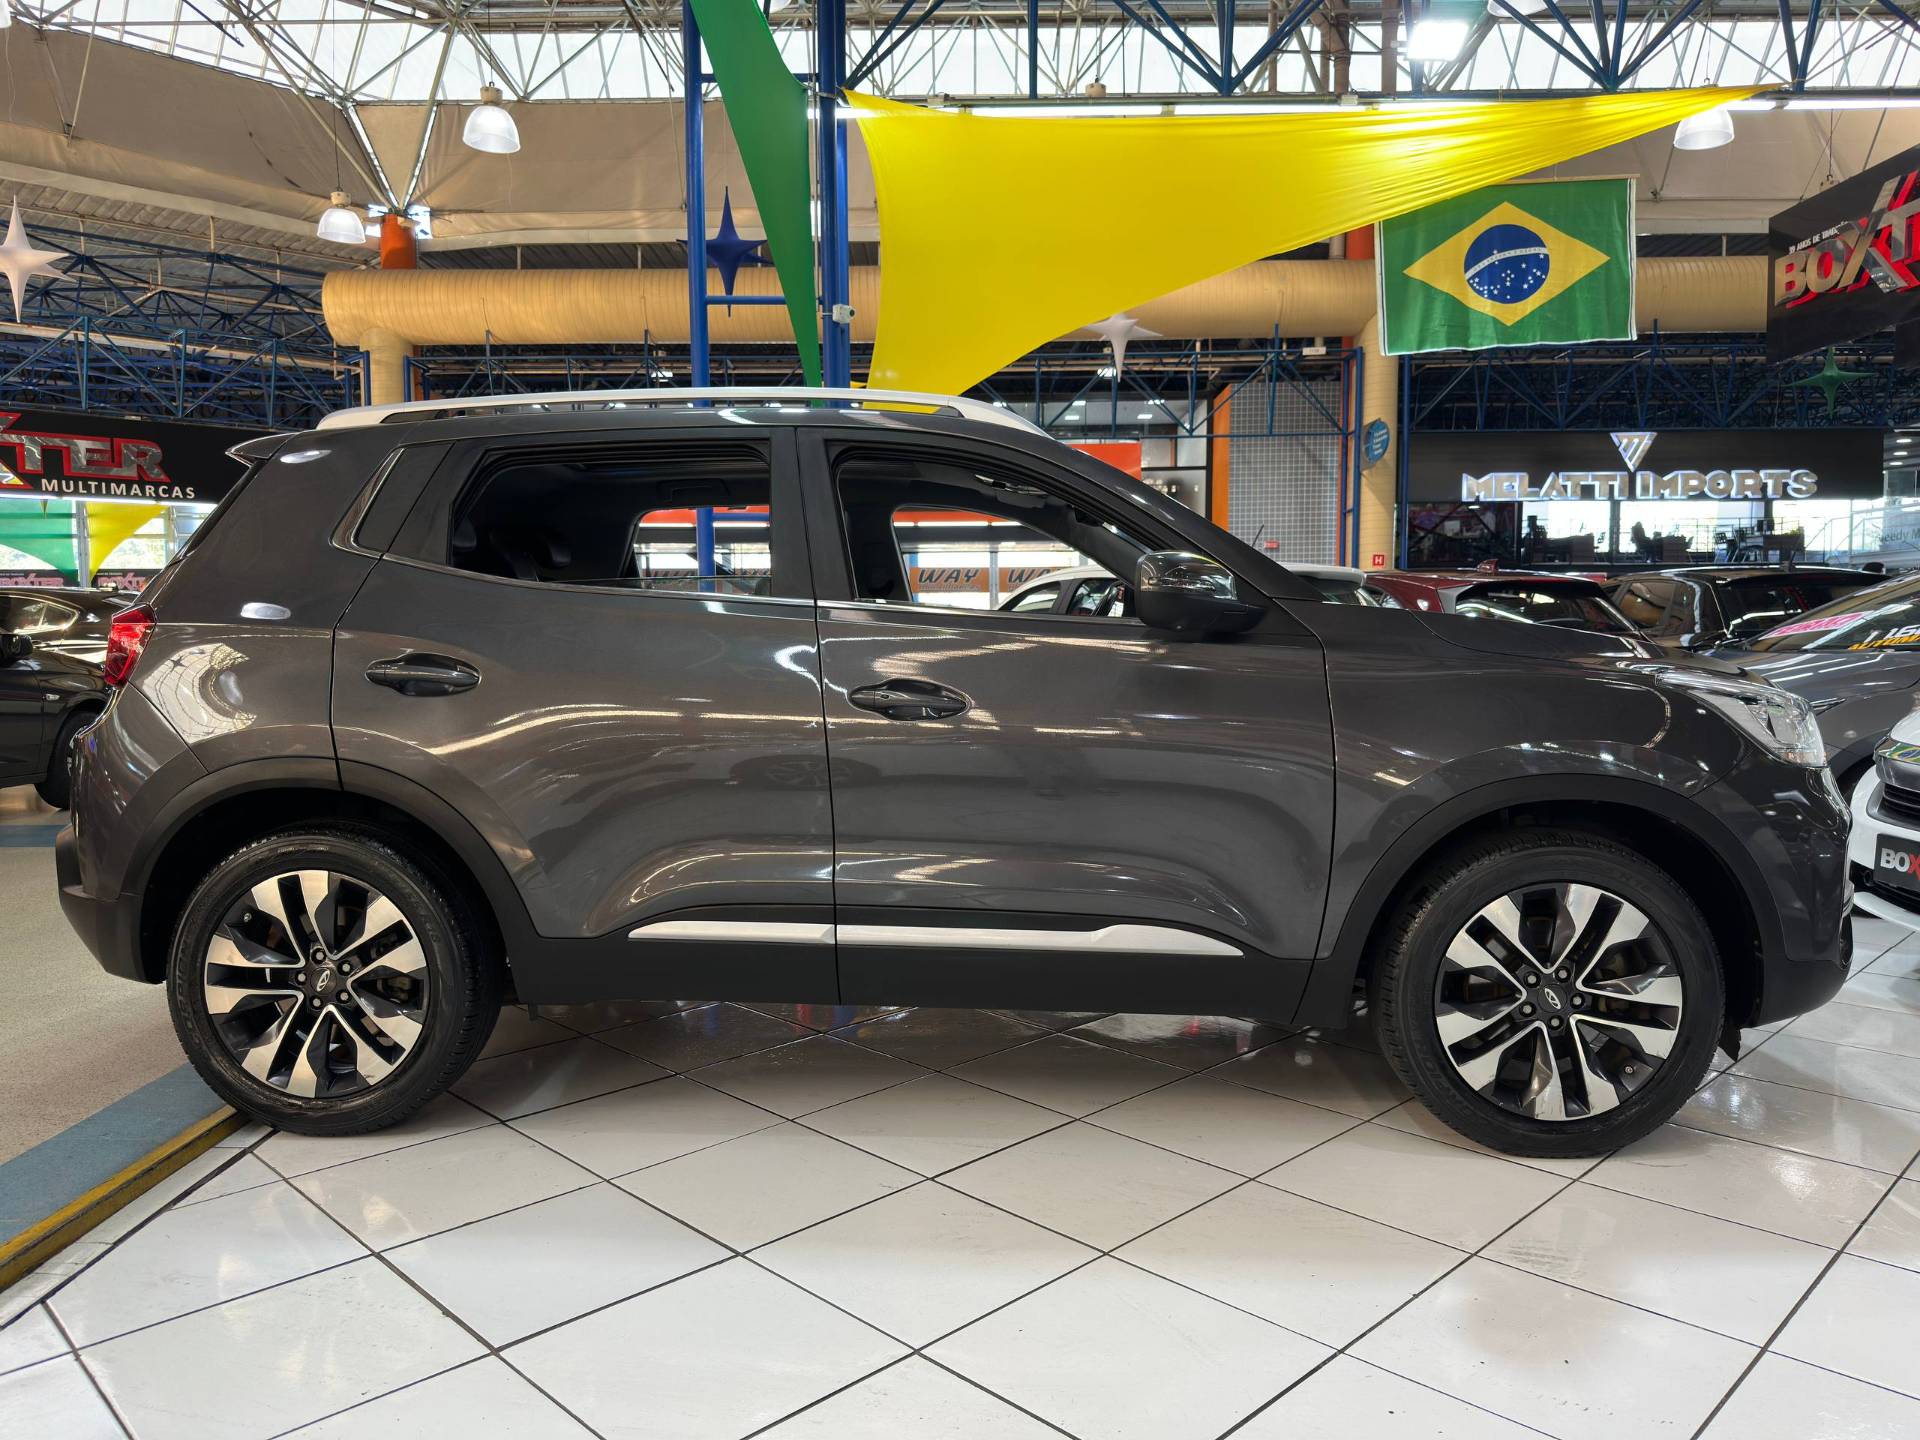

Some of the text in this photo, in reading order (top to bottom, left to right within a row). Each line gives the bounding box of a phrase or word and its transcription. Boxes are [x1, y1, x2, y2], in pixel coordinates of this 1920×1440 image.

[41, 478, 196, 500] MULTIMARCAS
[1462, 469, 1818, 502] MELATTI IMPORTS
[918, 567, 980, 584] WAY
